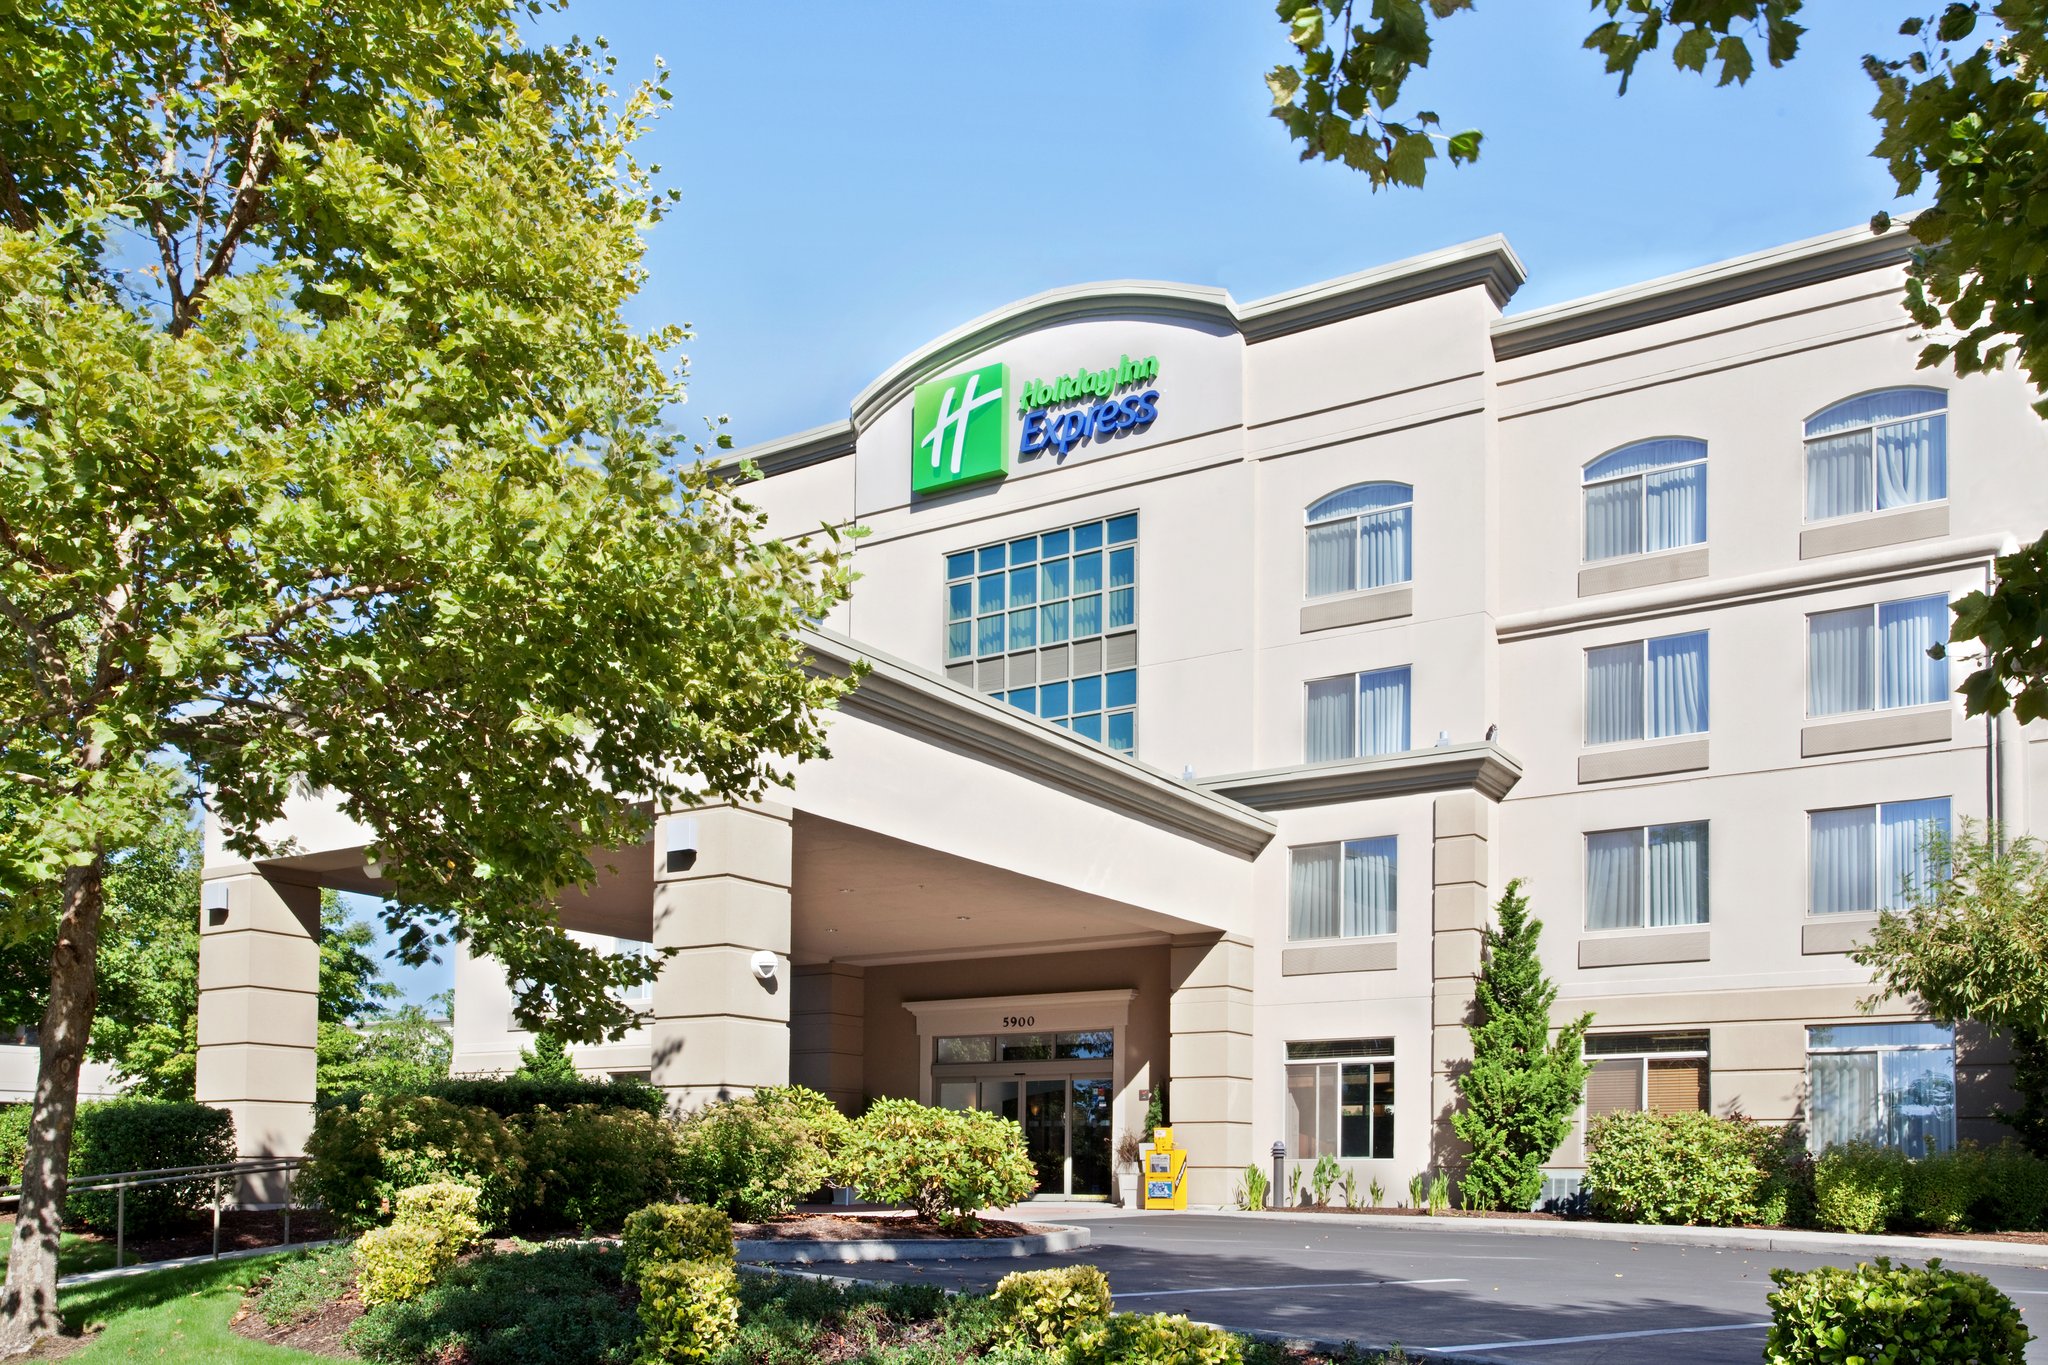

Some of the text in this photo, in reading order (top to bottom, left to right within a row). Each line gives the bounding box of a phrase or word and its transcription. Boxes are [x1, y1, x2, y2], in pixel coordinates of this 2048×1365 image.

[1018, 354, 1160, 412] Holiday Inn
[1019, 389, 1160, 455] Express
[1003, 1016, 1035, 1027] 5900
